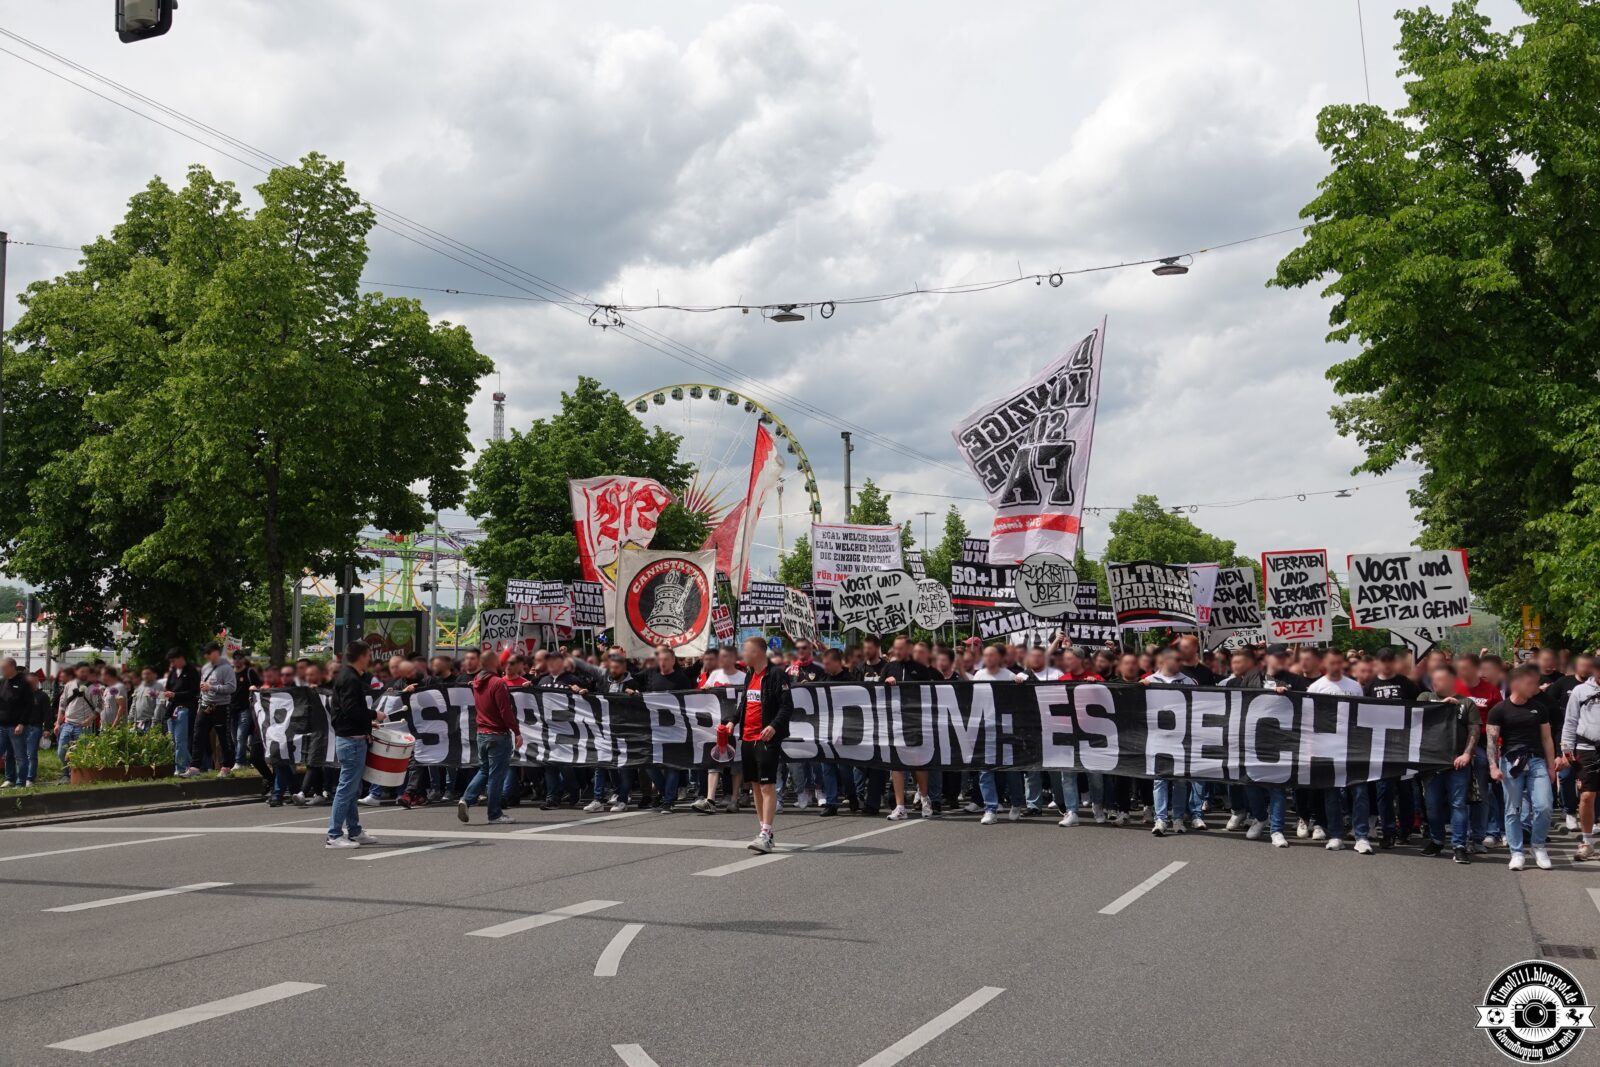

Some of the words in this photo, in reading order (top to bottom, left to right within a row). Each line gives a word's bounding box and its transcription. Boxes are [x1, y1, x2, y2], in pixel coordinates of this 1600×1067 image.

[816, 541, 833, 549] EGAL
[835, 542, 867, 552] WELCHER
[820, 552, 832, 560] DIE
[834, 553, 860, 562] EINZIGE
[1266, 554, 1324, 573] VERRATEN
[817, 570, 832, 580] FÜR
[834, 573, 850, 581] IMM
[836, 563, 853, 572] SIND
[952, 565, 998, 587] 50+1
[1111, 564, 1189, 587] ULTRAS
[1355, 556, 1411, 582] VOGT
[1419, 555, 1452, 577] und
[574, 582, 602, 593] VOGT
[632, 560, 707, 596] CANNSTATTER
[841, 574, 873, 594] VOGT
[877, 573, 902, 588] UND
[1281, 572, 1309, 586] UND
[507, 593, 539, 604] MAUL
[575, 592, 603, 606] UND
[840, 590, 883, 609] ADRION
[1112, 582, 1191, 602] BEDEUTET
[1268, 582, 1327, 605] VERKAUFT
[1357, 580, 1427, 605] ADRION
[576, 611, 605, 625] RAUS
[843, 607, 879, 623] ZEIT
[885, 603, 906, 616] ZU
[1223, 605, 1259, 624] RAUS
[1267, 600, 1328, 620] RÜCKTRITT
[1356, 604, 1398, 625] ZEIT
[1399, 604, 1419, 621] ZU
[1422, 597, 1468, 619] GEHN!
[866, 613, 907, 634] GEHEN
[980, 612, 1036, 639] MAUL
[1071, 624, 1123, 641] JETZT
[1271, 618, 1323, 638] JETZT!
[1034, 685, 1120, 772] ES
[1144, 688, 1424, 789] REICHT!
